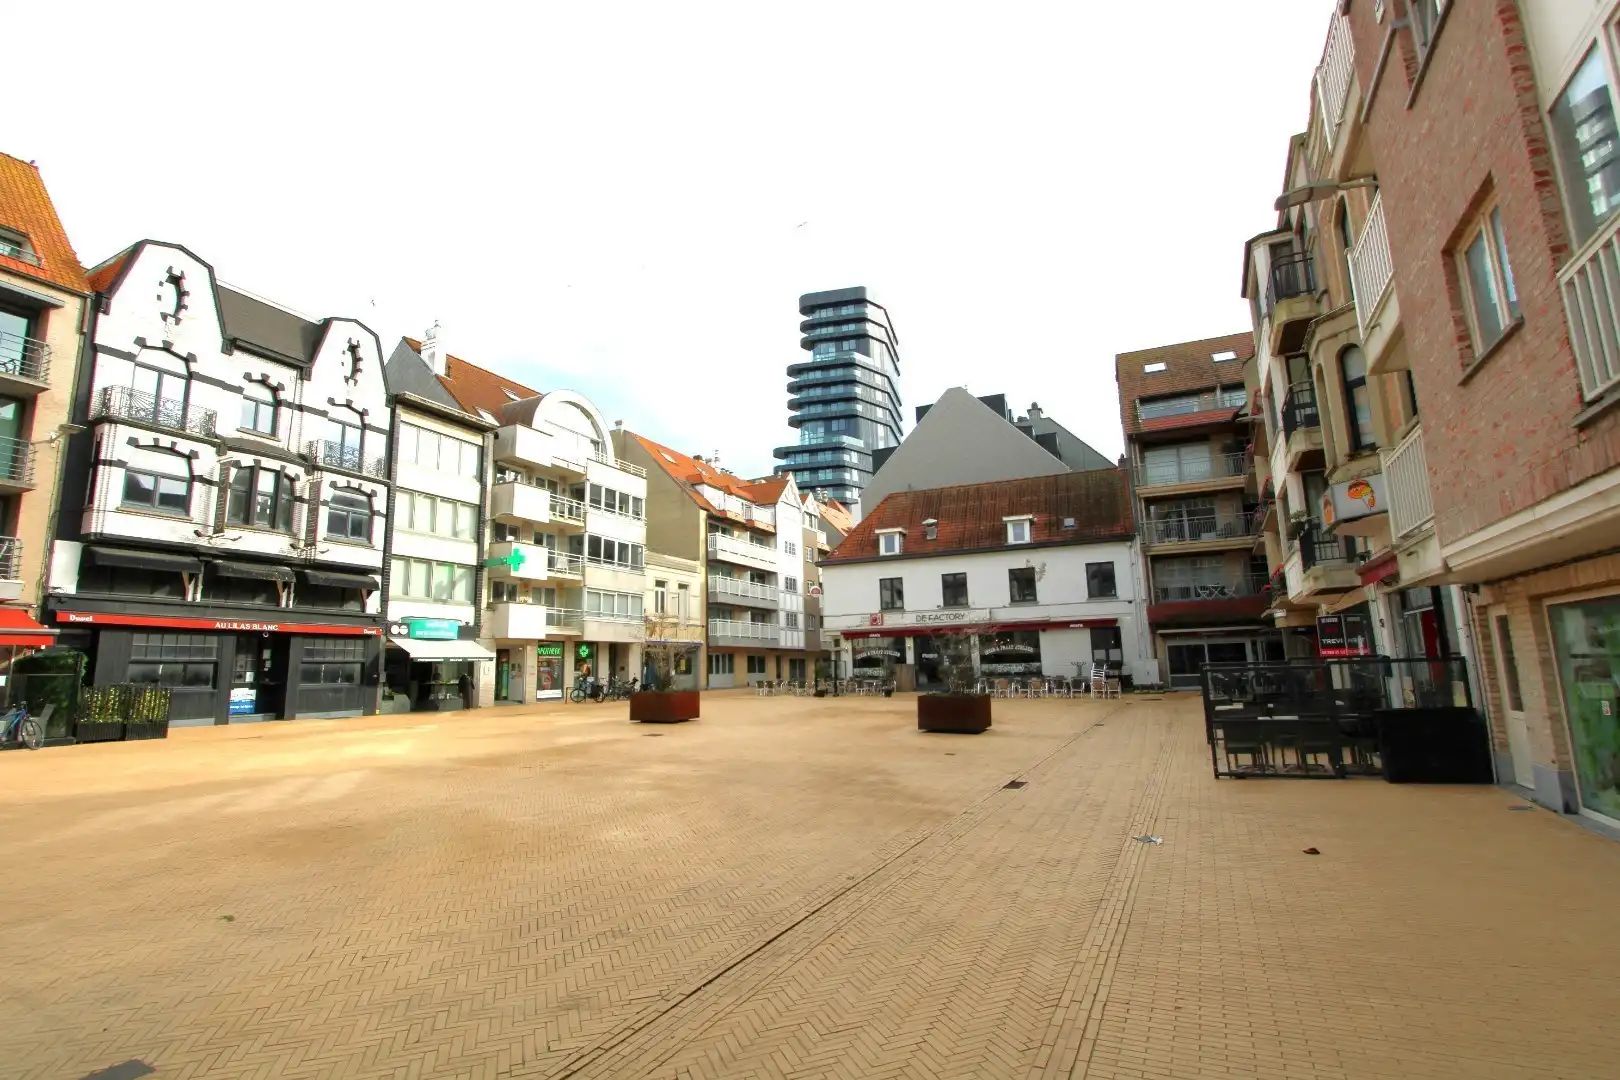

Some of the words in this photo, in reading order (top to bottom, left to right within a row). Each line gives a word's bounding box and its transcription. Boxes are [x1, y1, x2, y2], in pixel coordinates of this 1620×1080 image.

[69, 614, 93, 622] Duvel
[915, 614, 927, 622] DE
[928, 612, 966, 622] FACTORY
[227, 622, 251, 630] LILAS
[252, 623, 279, 631] BLANC
